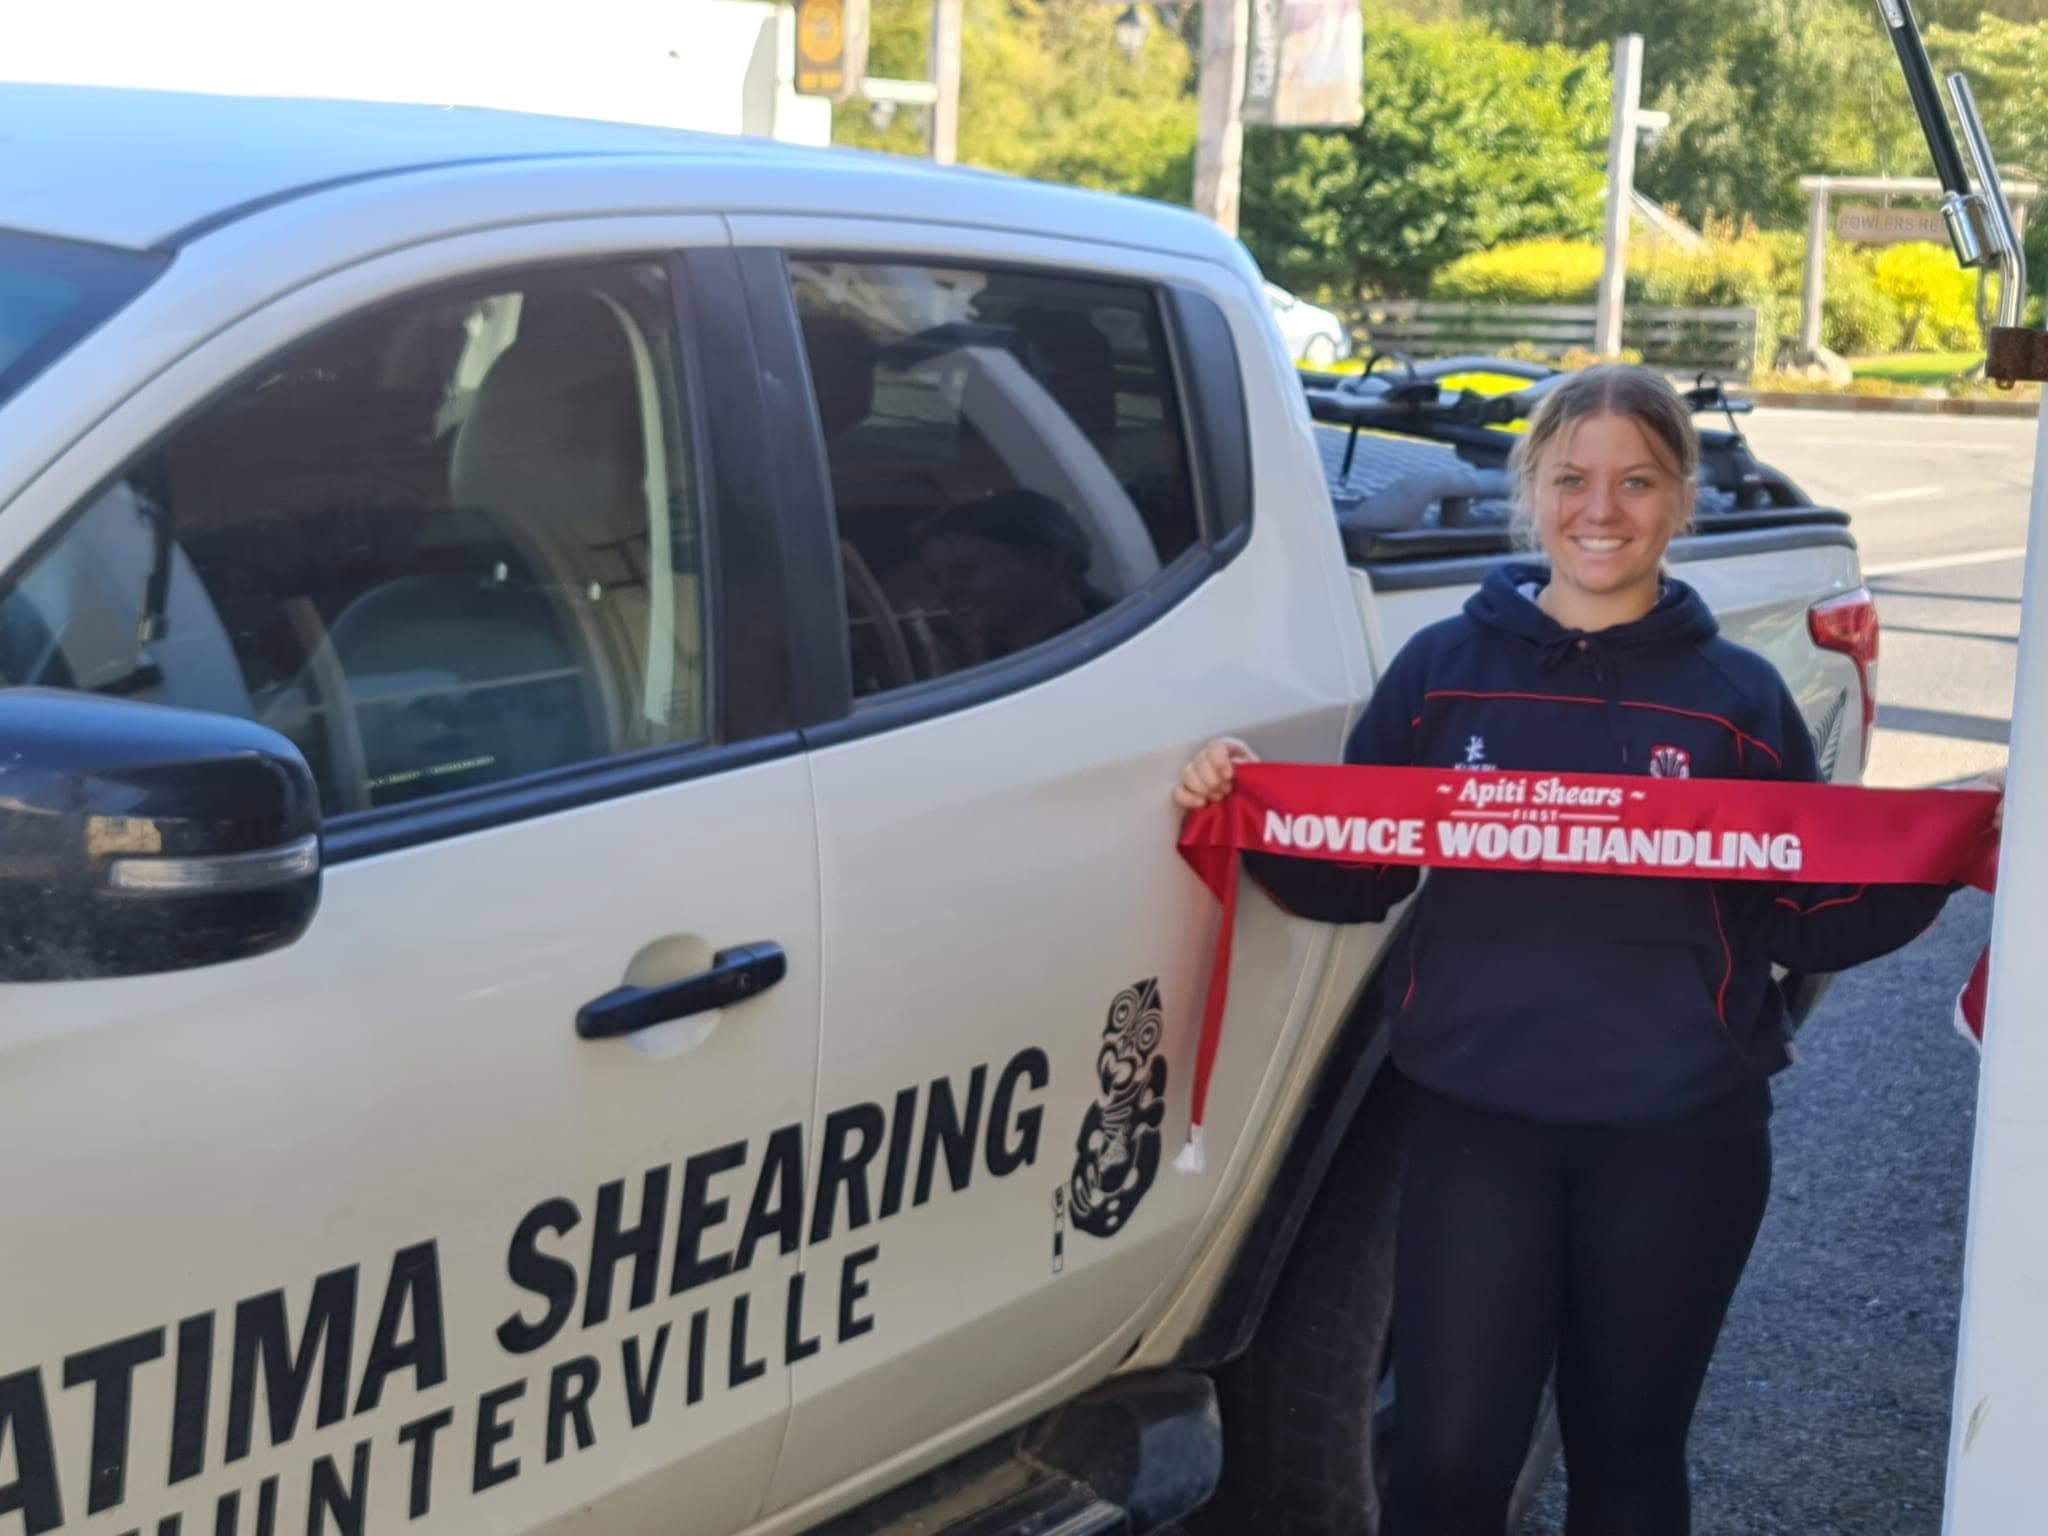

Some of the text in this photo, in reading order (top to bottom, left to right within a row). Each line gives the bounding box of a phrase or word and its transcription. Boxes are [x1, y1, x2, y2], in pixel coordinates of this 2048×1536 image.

[1459, 777, 1623, 809] Apiti Shears
[1512, 808, 1559, 822] FIRST
[1263, 810, 1803, 871] NOVICE WOOLHANDLING
[497, 1048, 1048, 1354] SHEARING
